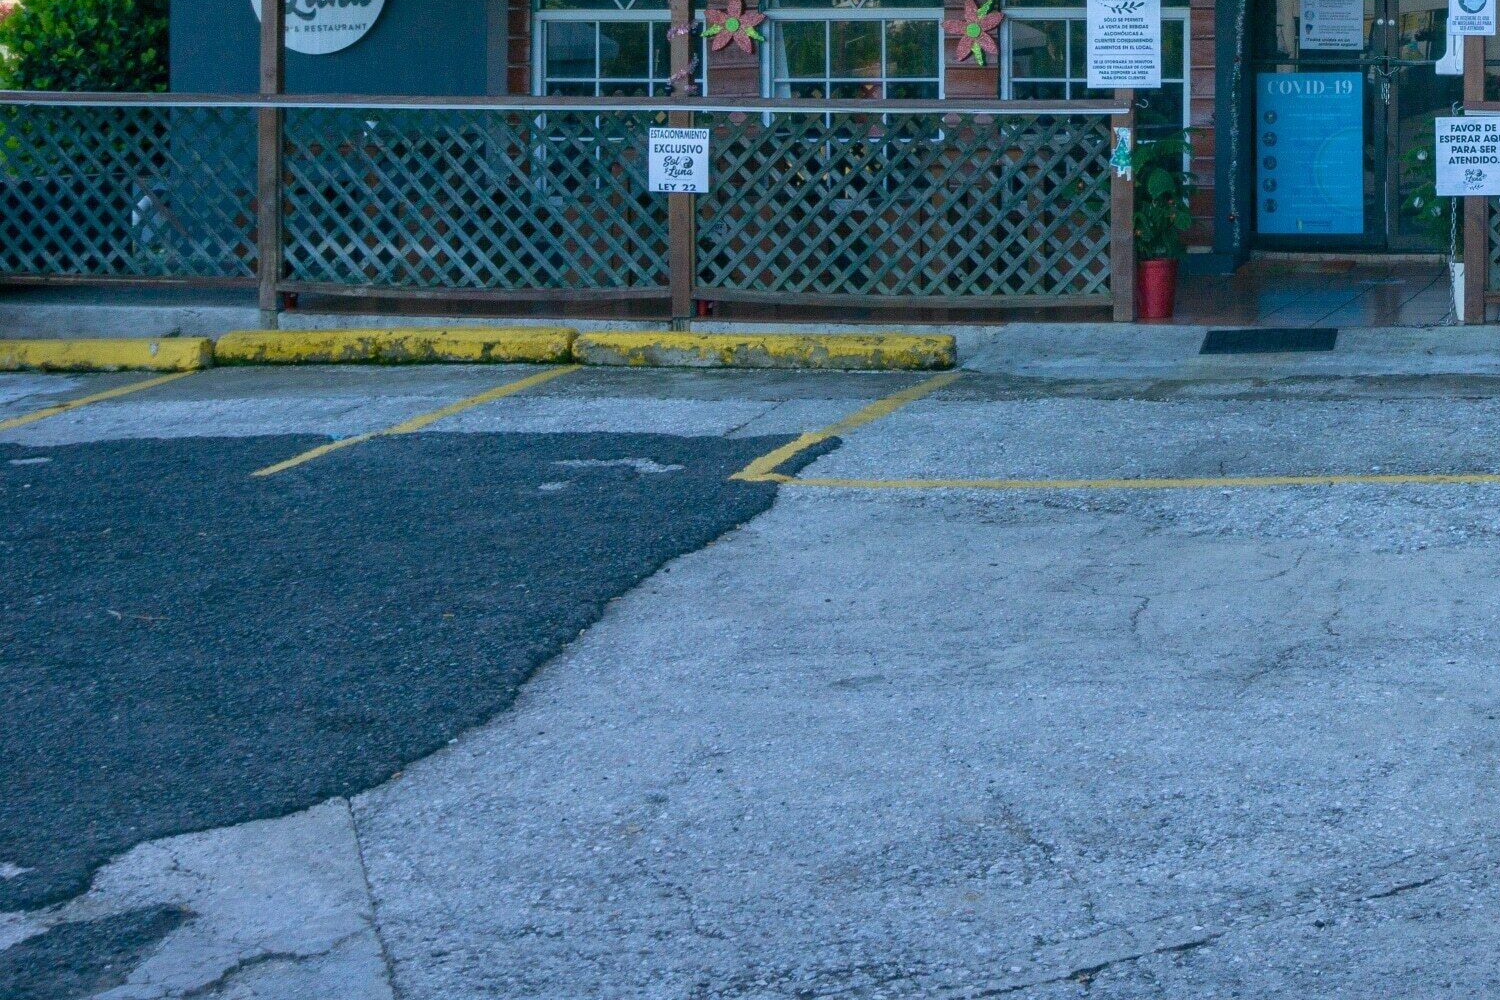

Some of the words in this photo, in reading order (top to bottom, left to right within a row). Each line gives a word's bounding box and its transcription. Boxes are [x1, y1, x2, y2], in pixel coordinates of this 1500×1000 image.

[304, 24, 366, 32] RESTAURANT
[1268, 80, 1353, 95] COVID-19
[1451, 124, 1481, 132] FAVOR
[650, 130, 707, 139] ESTACIONAMIENTO
[1440, 135, 1480, 143] ESPERAR
[654, 144, 703, 154] EXCLUSIVO
[663, 156, 680, 167] Sol
[1449, 156, 1500, 164] ATENDIDO.
[668, 166, 693, 178] Luna
